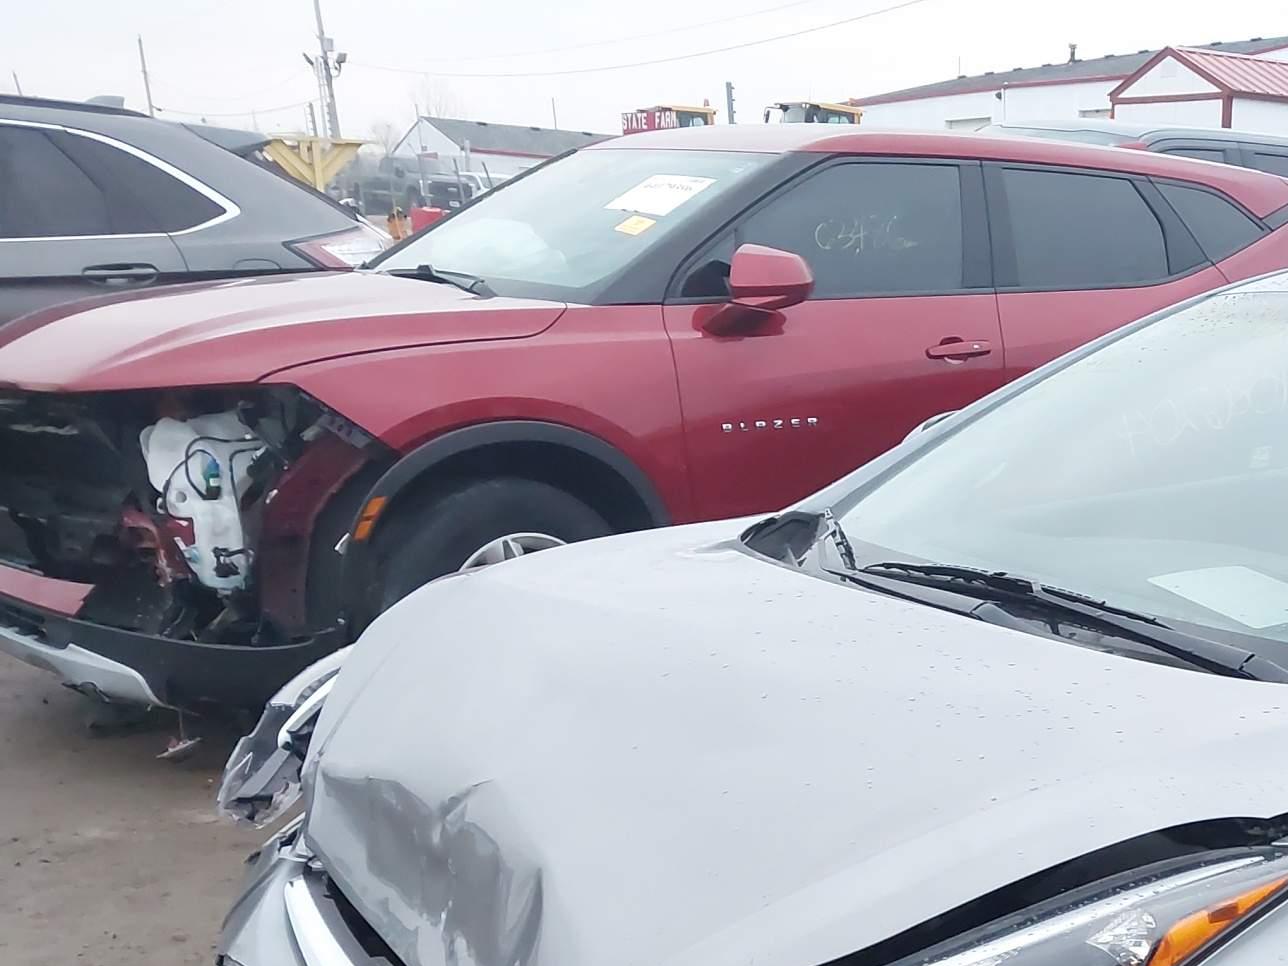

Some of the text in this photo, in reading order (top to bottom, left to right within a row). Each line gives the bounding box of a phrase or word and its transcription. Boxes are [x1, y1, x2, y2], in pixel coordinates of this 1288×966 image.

[622, 110, 680, 130] STATE FARM
[721, 416, 819, 433] BLAZER
